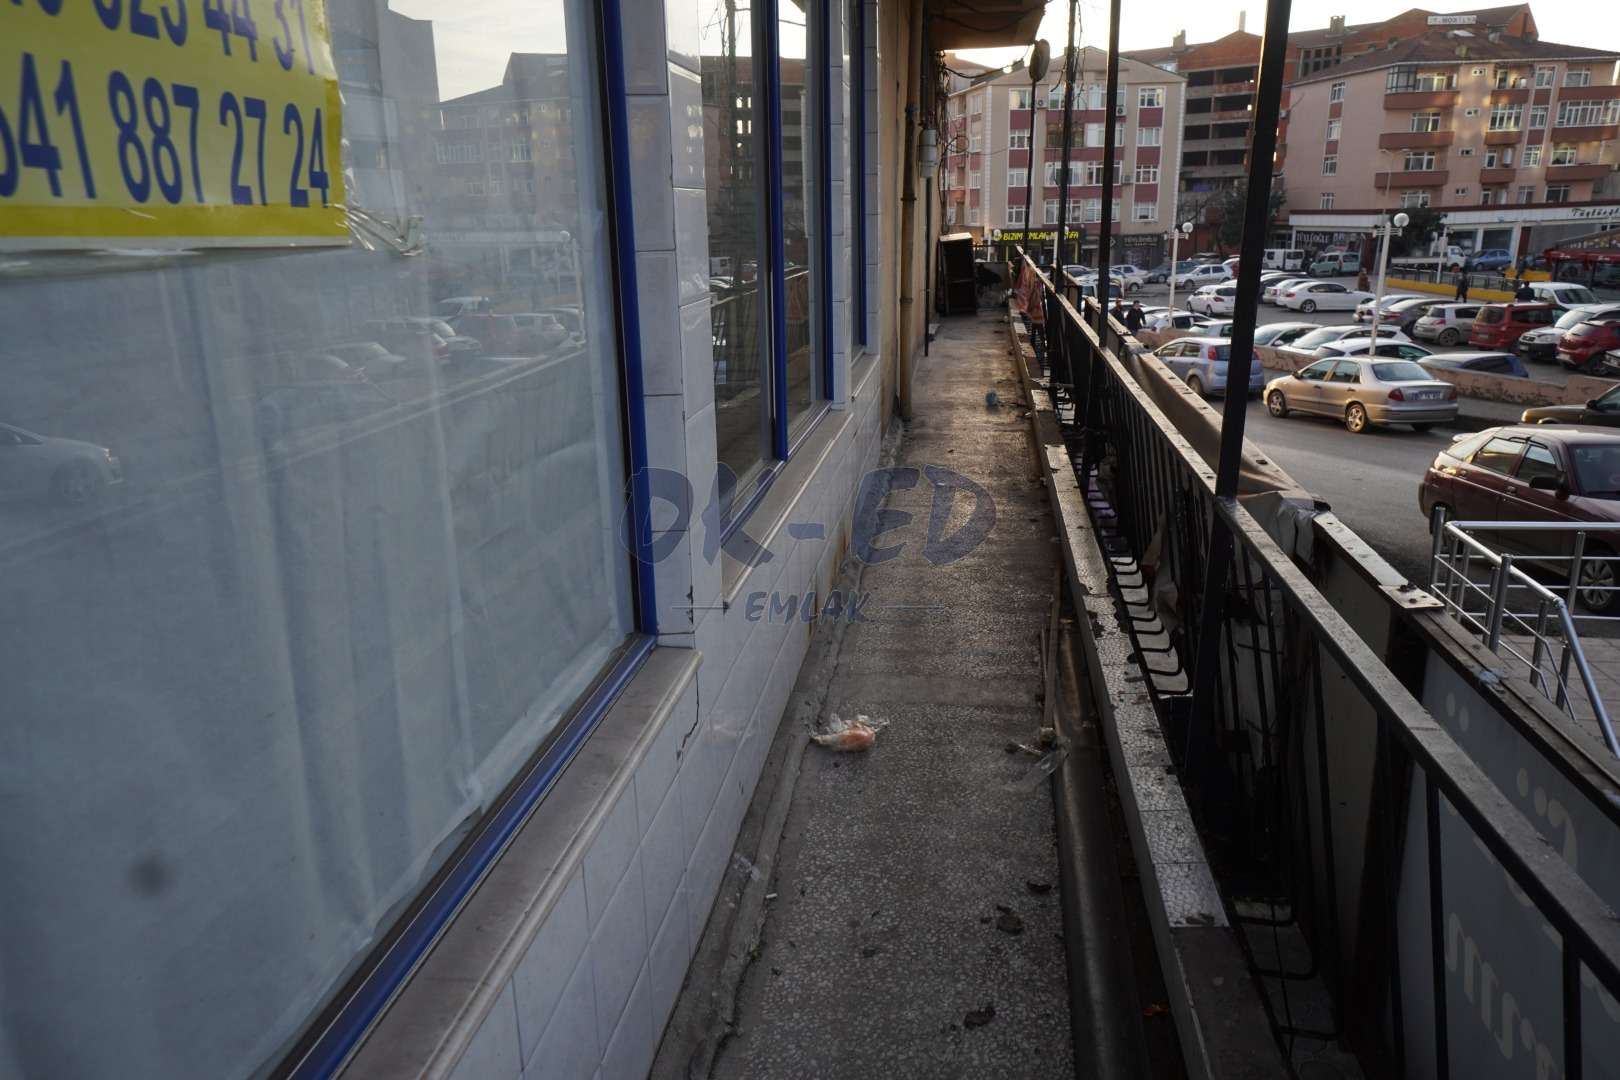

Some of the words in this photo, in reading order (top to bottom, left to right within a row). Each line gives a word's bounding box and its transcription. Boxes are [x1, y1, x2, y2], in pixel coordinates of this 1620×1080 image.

[107, 70, 206, 205] 887
[219, 90, 268, 206] 27
[283, 102, 330, 208] 24
